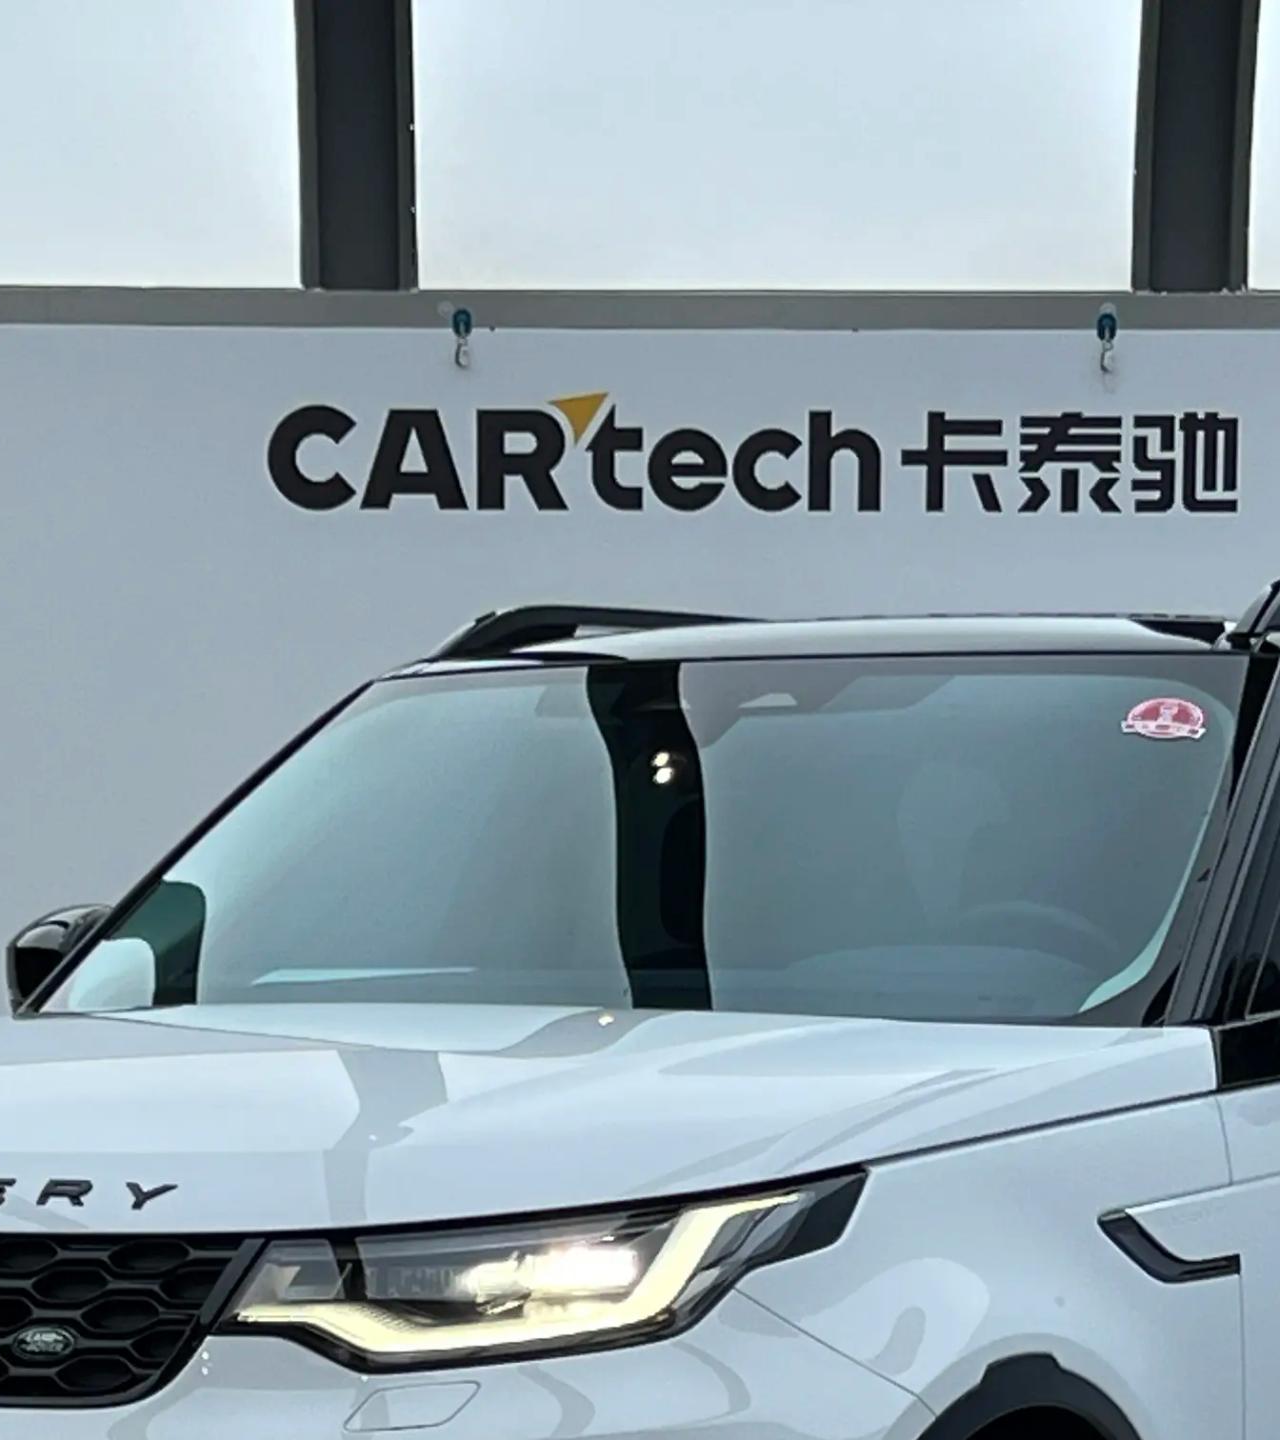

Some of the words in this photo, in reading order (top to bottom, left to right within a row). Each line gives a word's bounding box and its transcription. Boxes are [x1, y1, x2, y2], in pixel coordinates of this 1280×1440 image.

[267, 403, 883, 513] CARtech
[901, 410, 1240, 513] 卡泰驰
